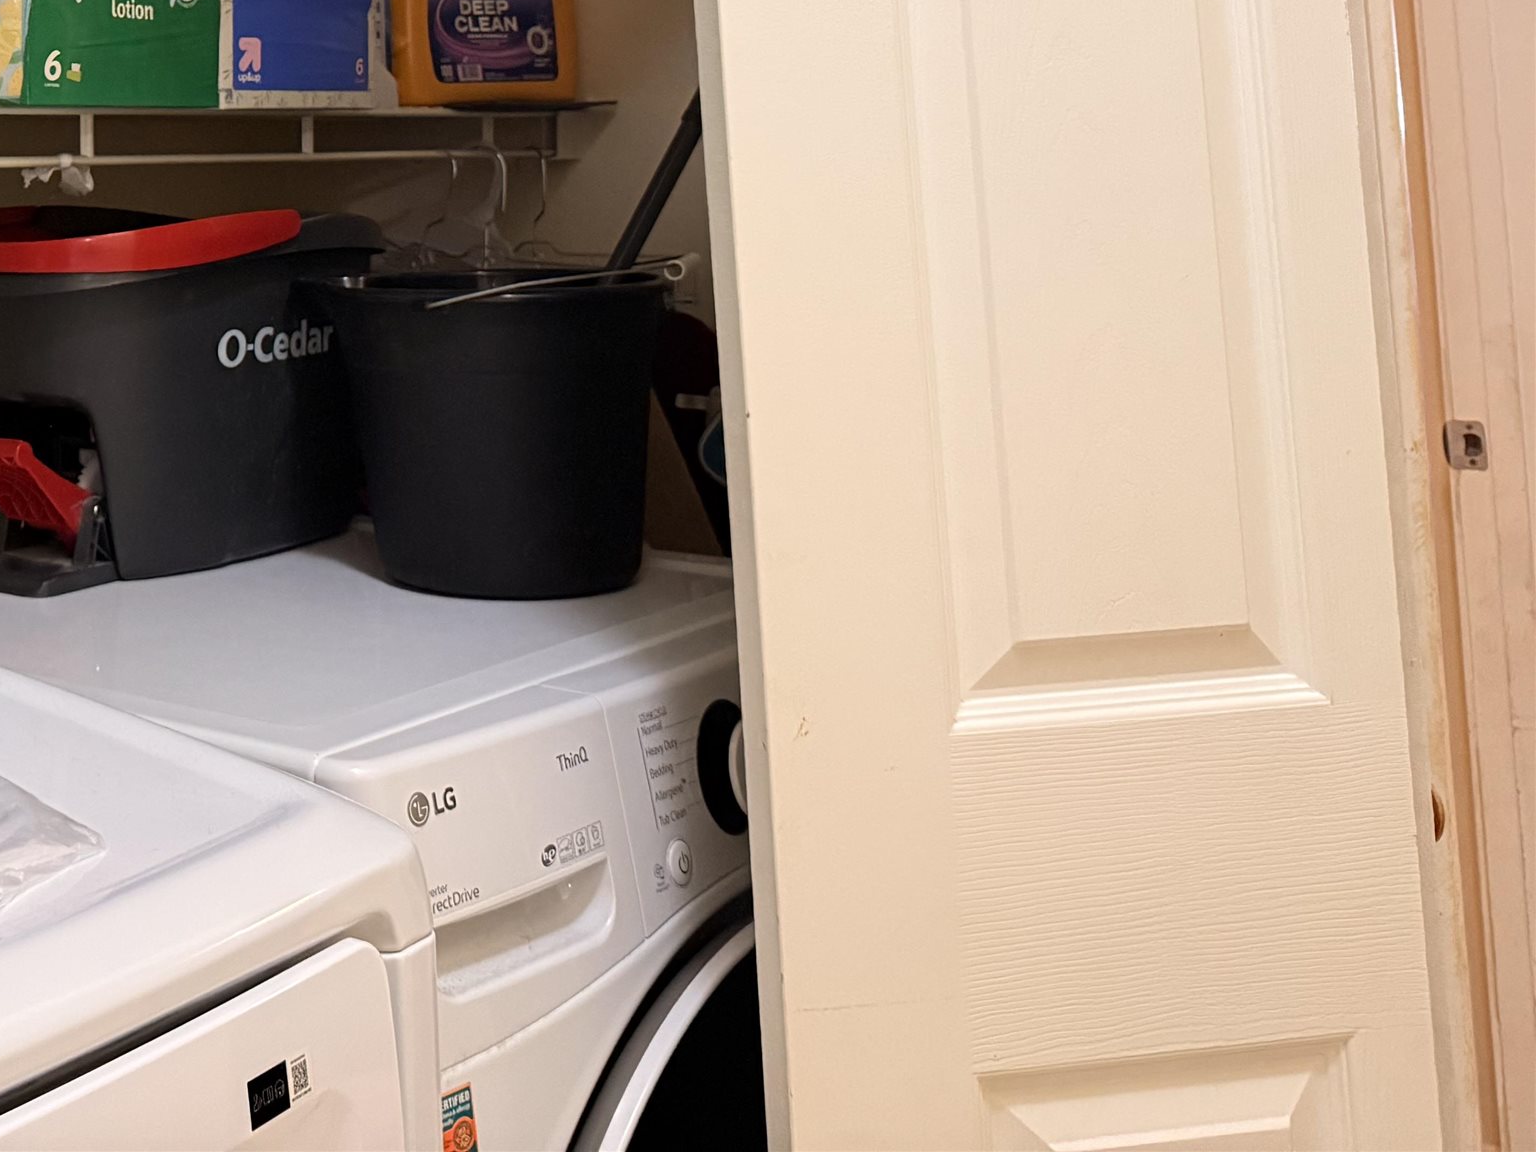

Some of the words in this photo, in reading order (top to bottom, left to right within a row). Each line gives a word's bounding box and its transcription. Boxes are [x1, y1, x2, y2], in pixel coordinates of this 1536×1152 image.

[459, 0, 510, 15] DEEP
[455, 16, 518, 33] CLEAN
[44, 49, 62, 82] 6
[355, 58, 364, 76] 6
[217, 319, 333, 368] O-Cedar
[555, 745, 589, 772] ThinQ
[431, 786, 457, 815] LG
